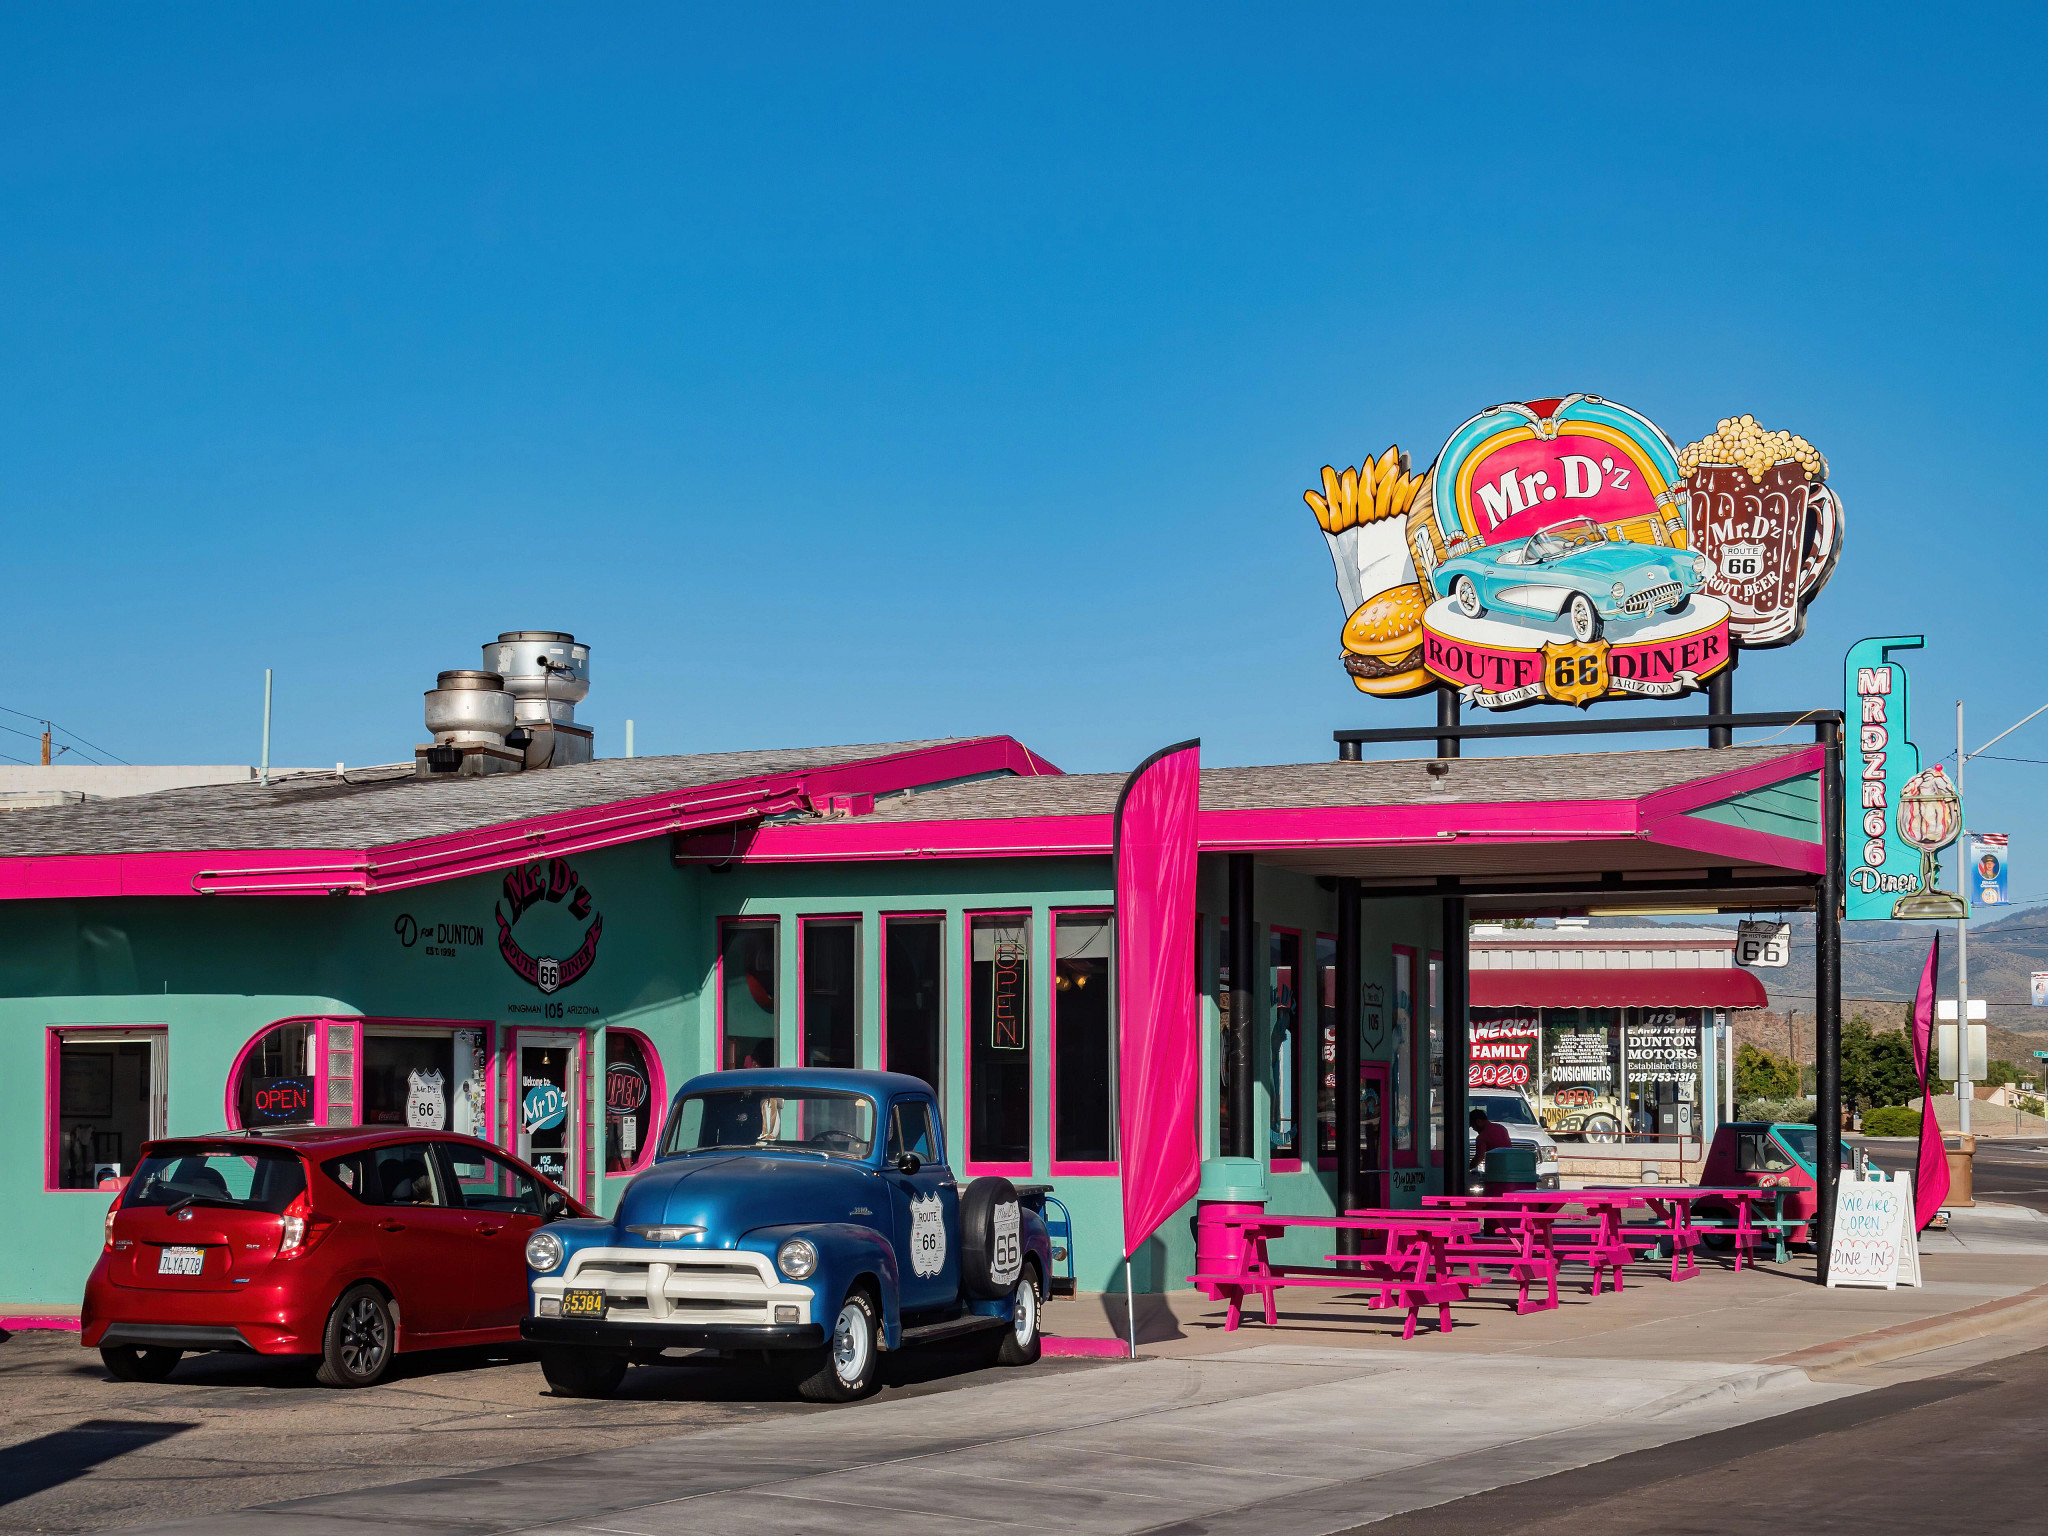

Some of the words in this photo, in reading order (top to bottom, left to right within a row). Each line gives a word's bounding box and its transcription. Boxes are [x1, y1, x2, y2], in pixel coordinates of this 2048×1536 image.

[1475, 467, 1557, 533] Mr.
[1554, 455, 1631, 499] D'z
[1709, 517, 1750, 545] Mr.
[1751, 516, 1782, 539] D'z
[1727, 547, 1759, 555] ROUTE
[1729, 559, 1756, 574] 66
[1708, 574, 1741, 597] ROOT
[1743, 571, 1780, 597] BEER
[1429, 637, 1534, 688] ROUTE
[1555, 655, 1598, 687] 66
[1611, 635, 1719, 680] DINER
[1481, 684, 1540, 706] KINGMAN
[1613, 678, 1675, 694] ARIZONA
[1849, 866, 1919, 893] Diner
[504, 862, 547, 925] Mr.
[394, 913, 418, 947] D
[437, 923, 484, 946] DUNTON
[440, 948, 456, 957] 1992
[1743, 941, 1781, 962] 66
[502, 937, 537, 977] ROUTE
[541, 966, 558, 985] 66
[559, 942, 592, 981] DINER
[995, 944, 1019, 1044] OPEN
[507, 1004, 542, 1014] KINGMAN
[544, 1003, 564, 1019] 105
[567, 1005, 600, 1016] ARIZONA
[1649, 1014, 1676, 1024] 119
[1368, 1013, 1379, 1031] 105
[1637, 1026, 1662, 1034] ANDY
[1663, 1025, 1697, 1034] DEVINE
[1629, 1036, 1697, 1047] DUNTON
[1472, 1045, 1529, 1058] FAMILY
[1627, 1049, 1698, 1060] MOTORS
[1628, 1061, 1677, 1070] Established
[1678, 1062, 1698, 1070] 1946
[1468, 1064, 1529, 1086] 2020
[1551, 1066, 1612, 1082] CONSIGNMENTS
[1628, 1073, 1697, 1083] 928-753-1314
[522, 1076, 543, 1089] Welcome
[256, 1089, 306, 1109] OPEN
[1555, 1090, 1595, 1106] OPEN
[419, 1103, 434, 1116] 66
[522, 1096, 545, 1124] Mr
[540, 1155, 552, 1165] 105
[533, 1164, 543, 1174] dy
[544, 1164, 564, 1174] Devine
[919, 1211, 937, 1222] ROUTE
[922, 1233, 936, 1251] 66
[997, 1232, 1018, 1265] 66
[163, 1256, 201, 1271] 7LYA778
[571, 1295, 602, 1311] 5384
